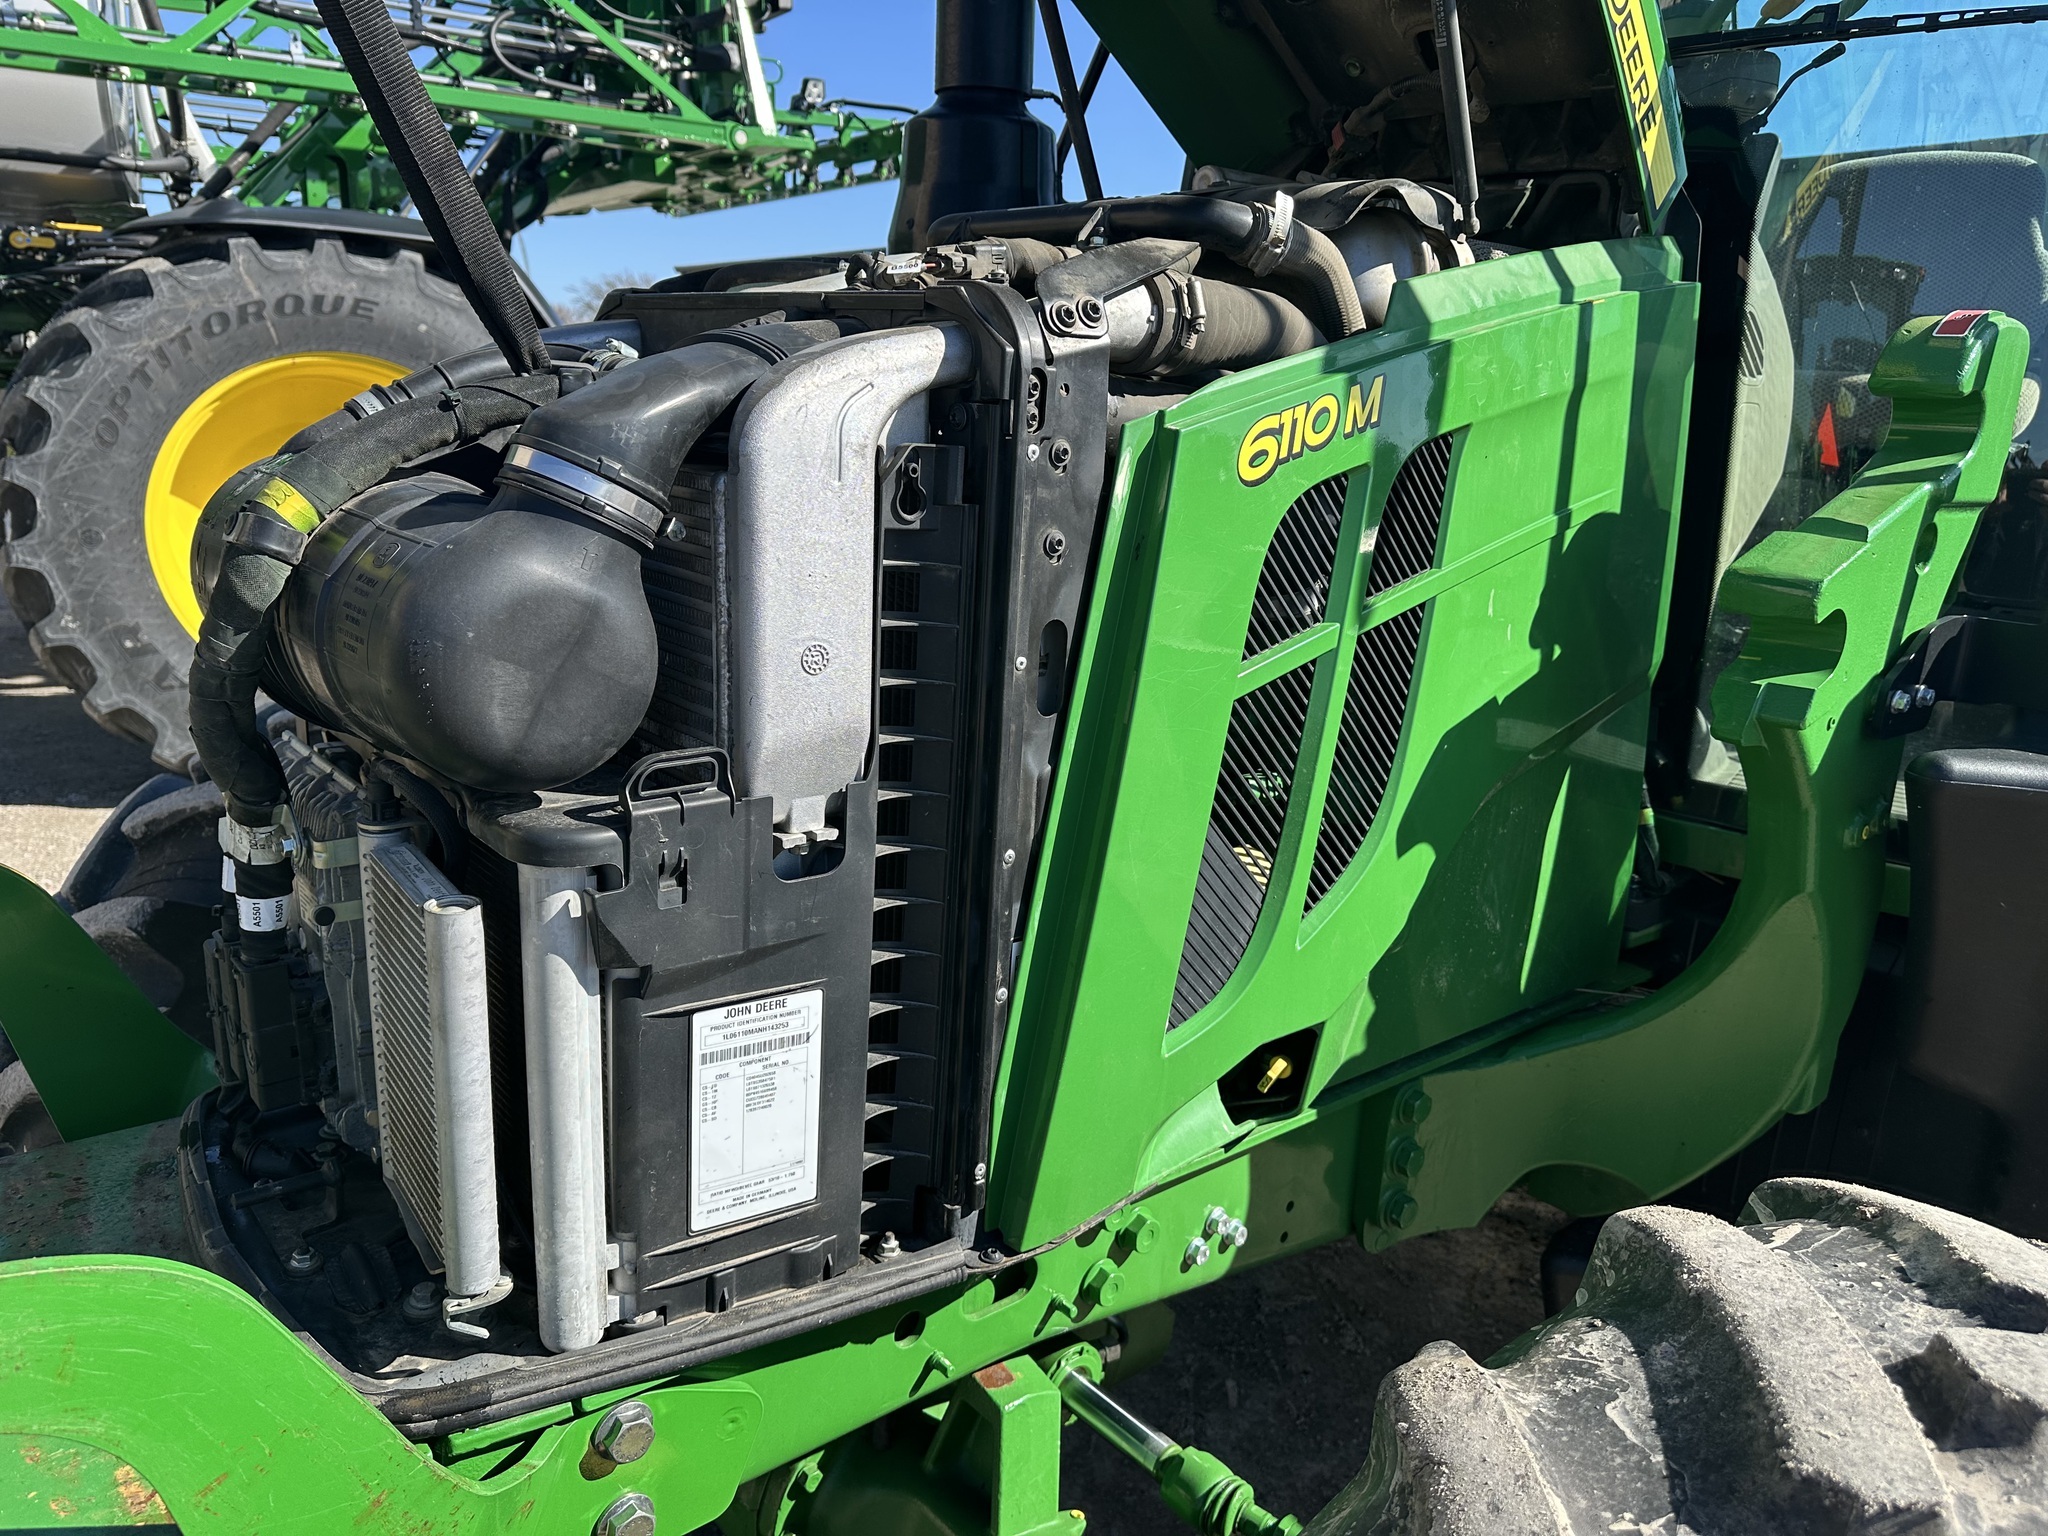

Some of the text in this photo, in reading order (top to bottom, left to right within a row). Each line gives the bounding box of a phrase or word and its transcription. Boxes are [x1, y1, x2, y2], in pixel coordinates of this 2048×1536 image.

[95, 293, 380, 449] OPTITORQUE
[1237, 373, 1387, 487] 6110 M
[252, 902, 262, 927] A5501
[724, 998, 788, 1019] JOHN DEERE
[710, 1009, 802, 1032] PRODUCT IDENTIFICATION NUMBER
[739, 1056, 771, 1067] COMPONENT
[762, 1062, 780, 1070] SERIAL
[715, 1072, 730, 1080] CODE
